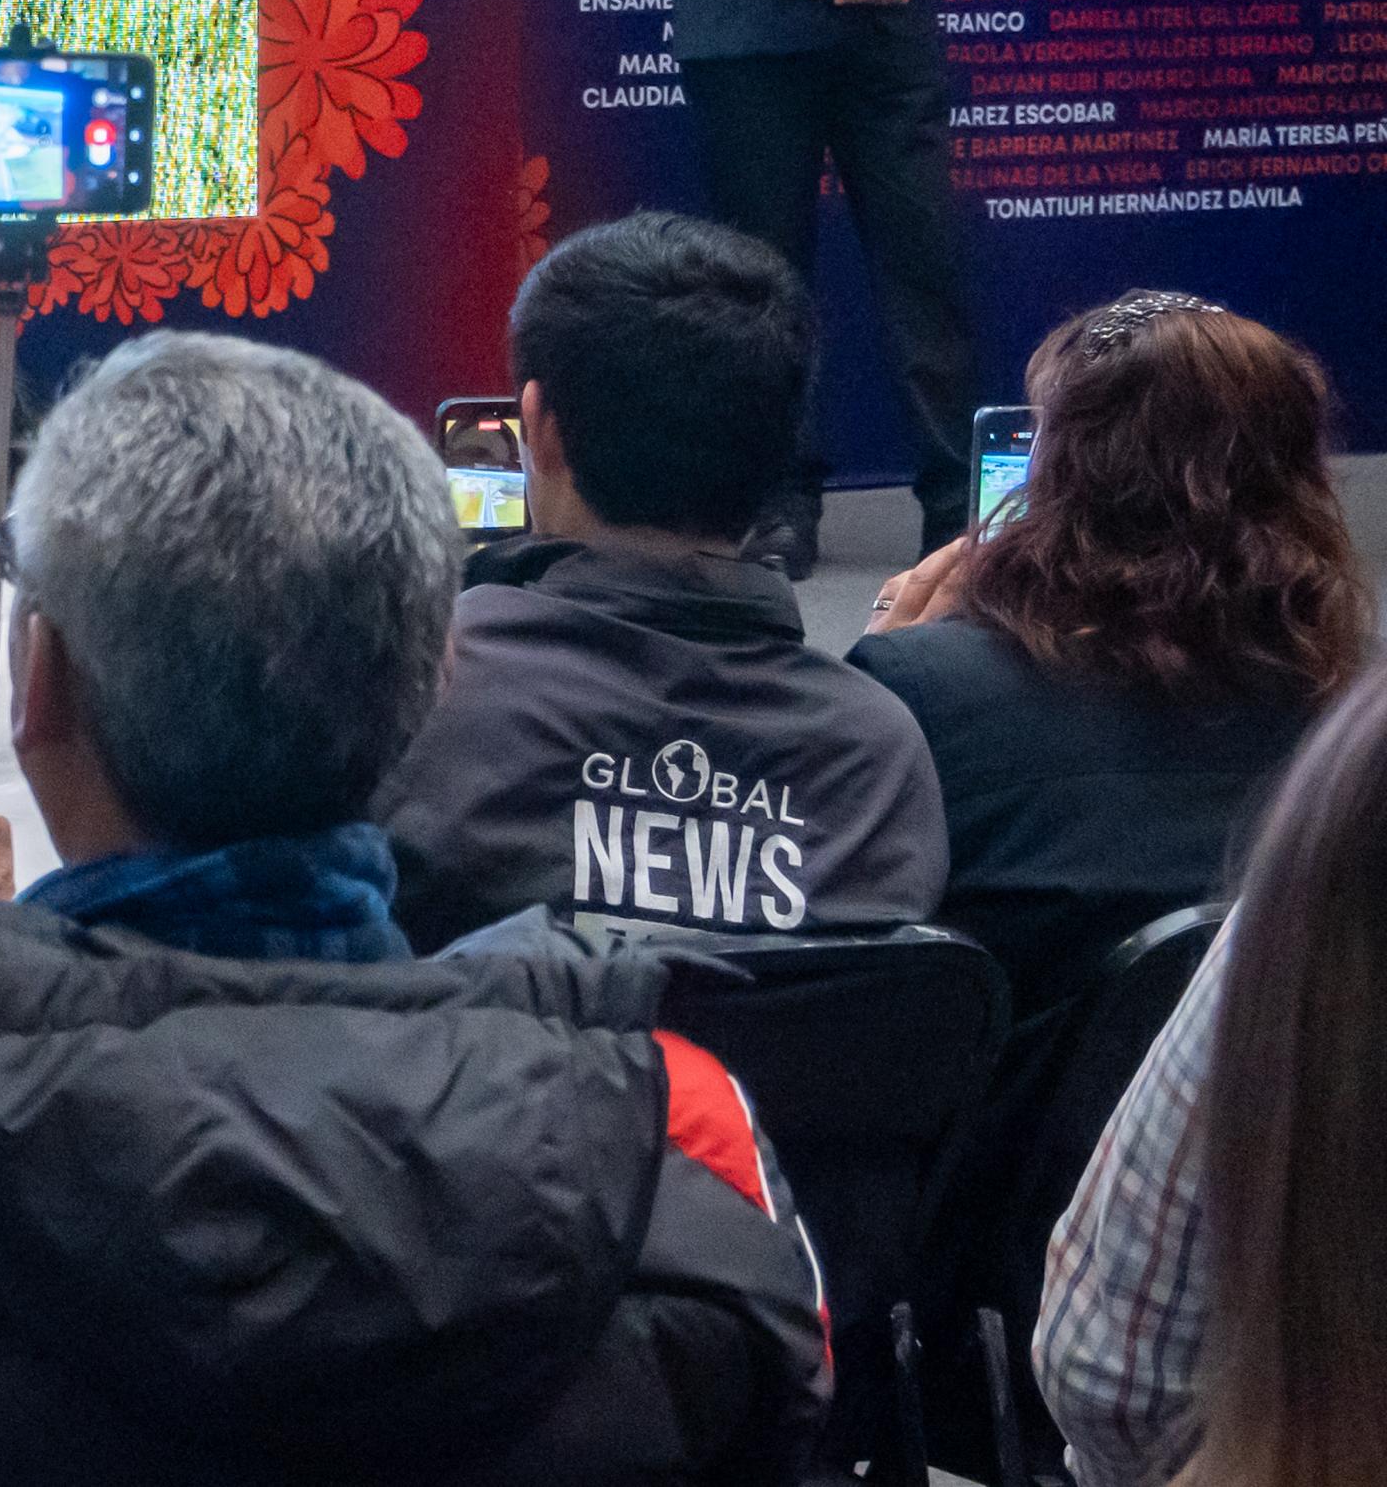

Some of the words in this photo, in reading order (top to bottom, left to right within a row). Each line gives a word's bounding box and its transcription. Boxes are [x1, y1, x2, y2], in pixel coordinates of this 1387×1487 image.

[583, 85, 685, 108] CLAUDIA
[1016, 102, 1115, 124] ESCOBAR
[1204, 122, 1272, 148] MARÍA
[1276, 123, 1349, 145] TERESA
[987, 196, 1093, 218] TONATIUH
[1100, 188, 1223, 216] HERNÁNDEZ
[1229, 185, 1302, 209] DÁVILA
[582, 739, 805, 827] GLOBAL
[574, 799, 807, 931] NEWS
